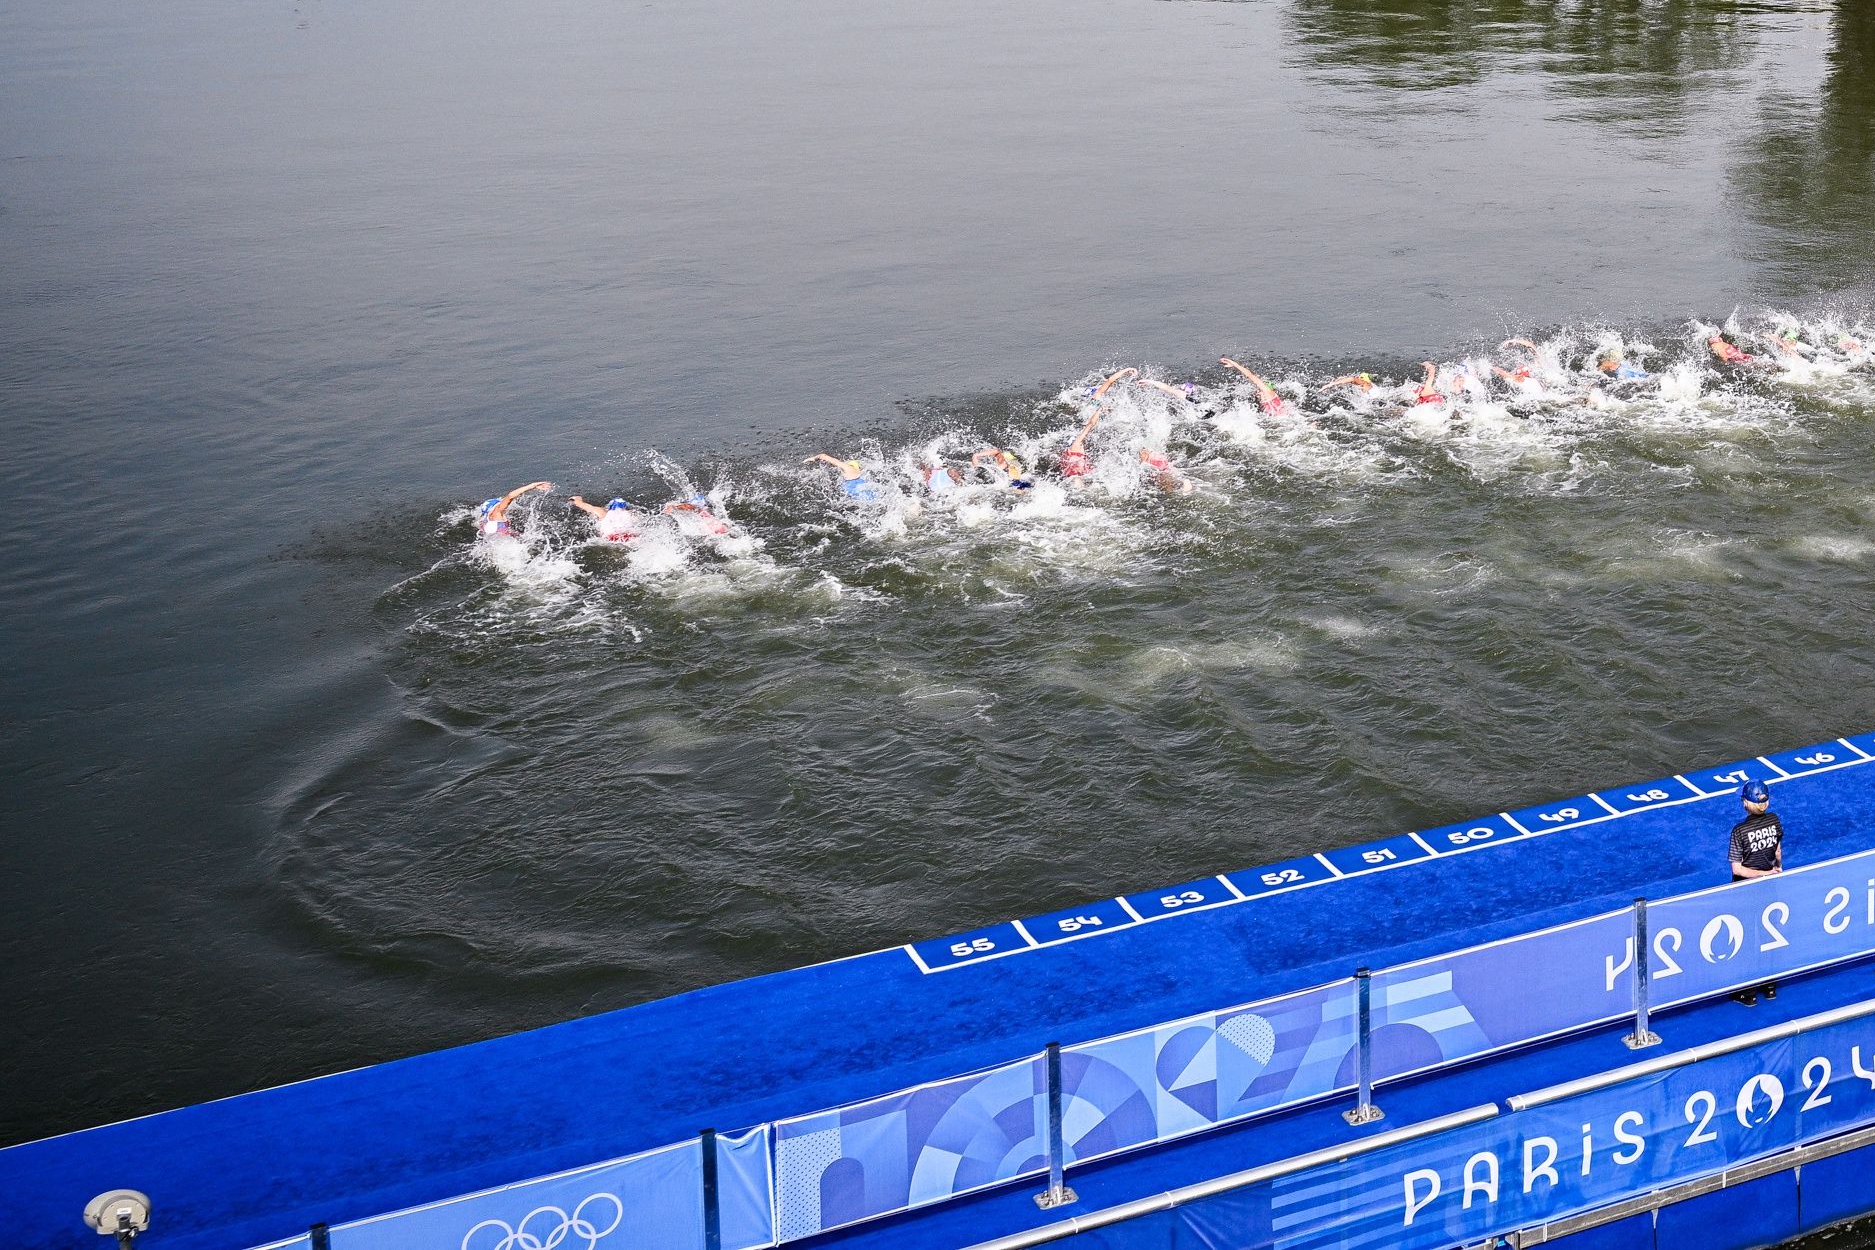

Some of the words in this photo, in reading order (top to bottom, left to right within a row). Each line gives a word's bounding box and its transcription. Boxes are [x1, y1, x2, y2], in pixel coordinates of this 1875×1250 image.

[1795, 753, 1835, 765] 46
[1714, 770, 1749, 783] 47
[1627, 790, 1669, 801] 48
[1539, 808, 1579, 822] 49
[1448, 828, 1493, 844] 50
[1748, 824, 1777, 843] PARIS
[1750, 836, 1778, 852] 2024
[1362, 848, 1396, 863] 51
[1261, 870, 1304, 885] 52
[1161, 892, 1204, 907] 53
[1059, 916, 1102, 931] 54
[951, 938, 995, 956] 55
